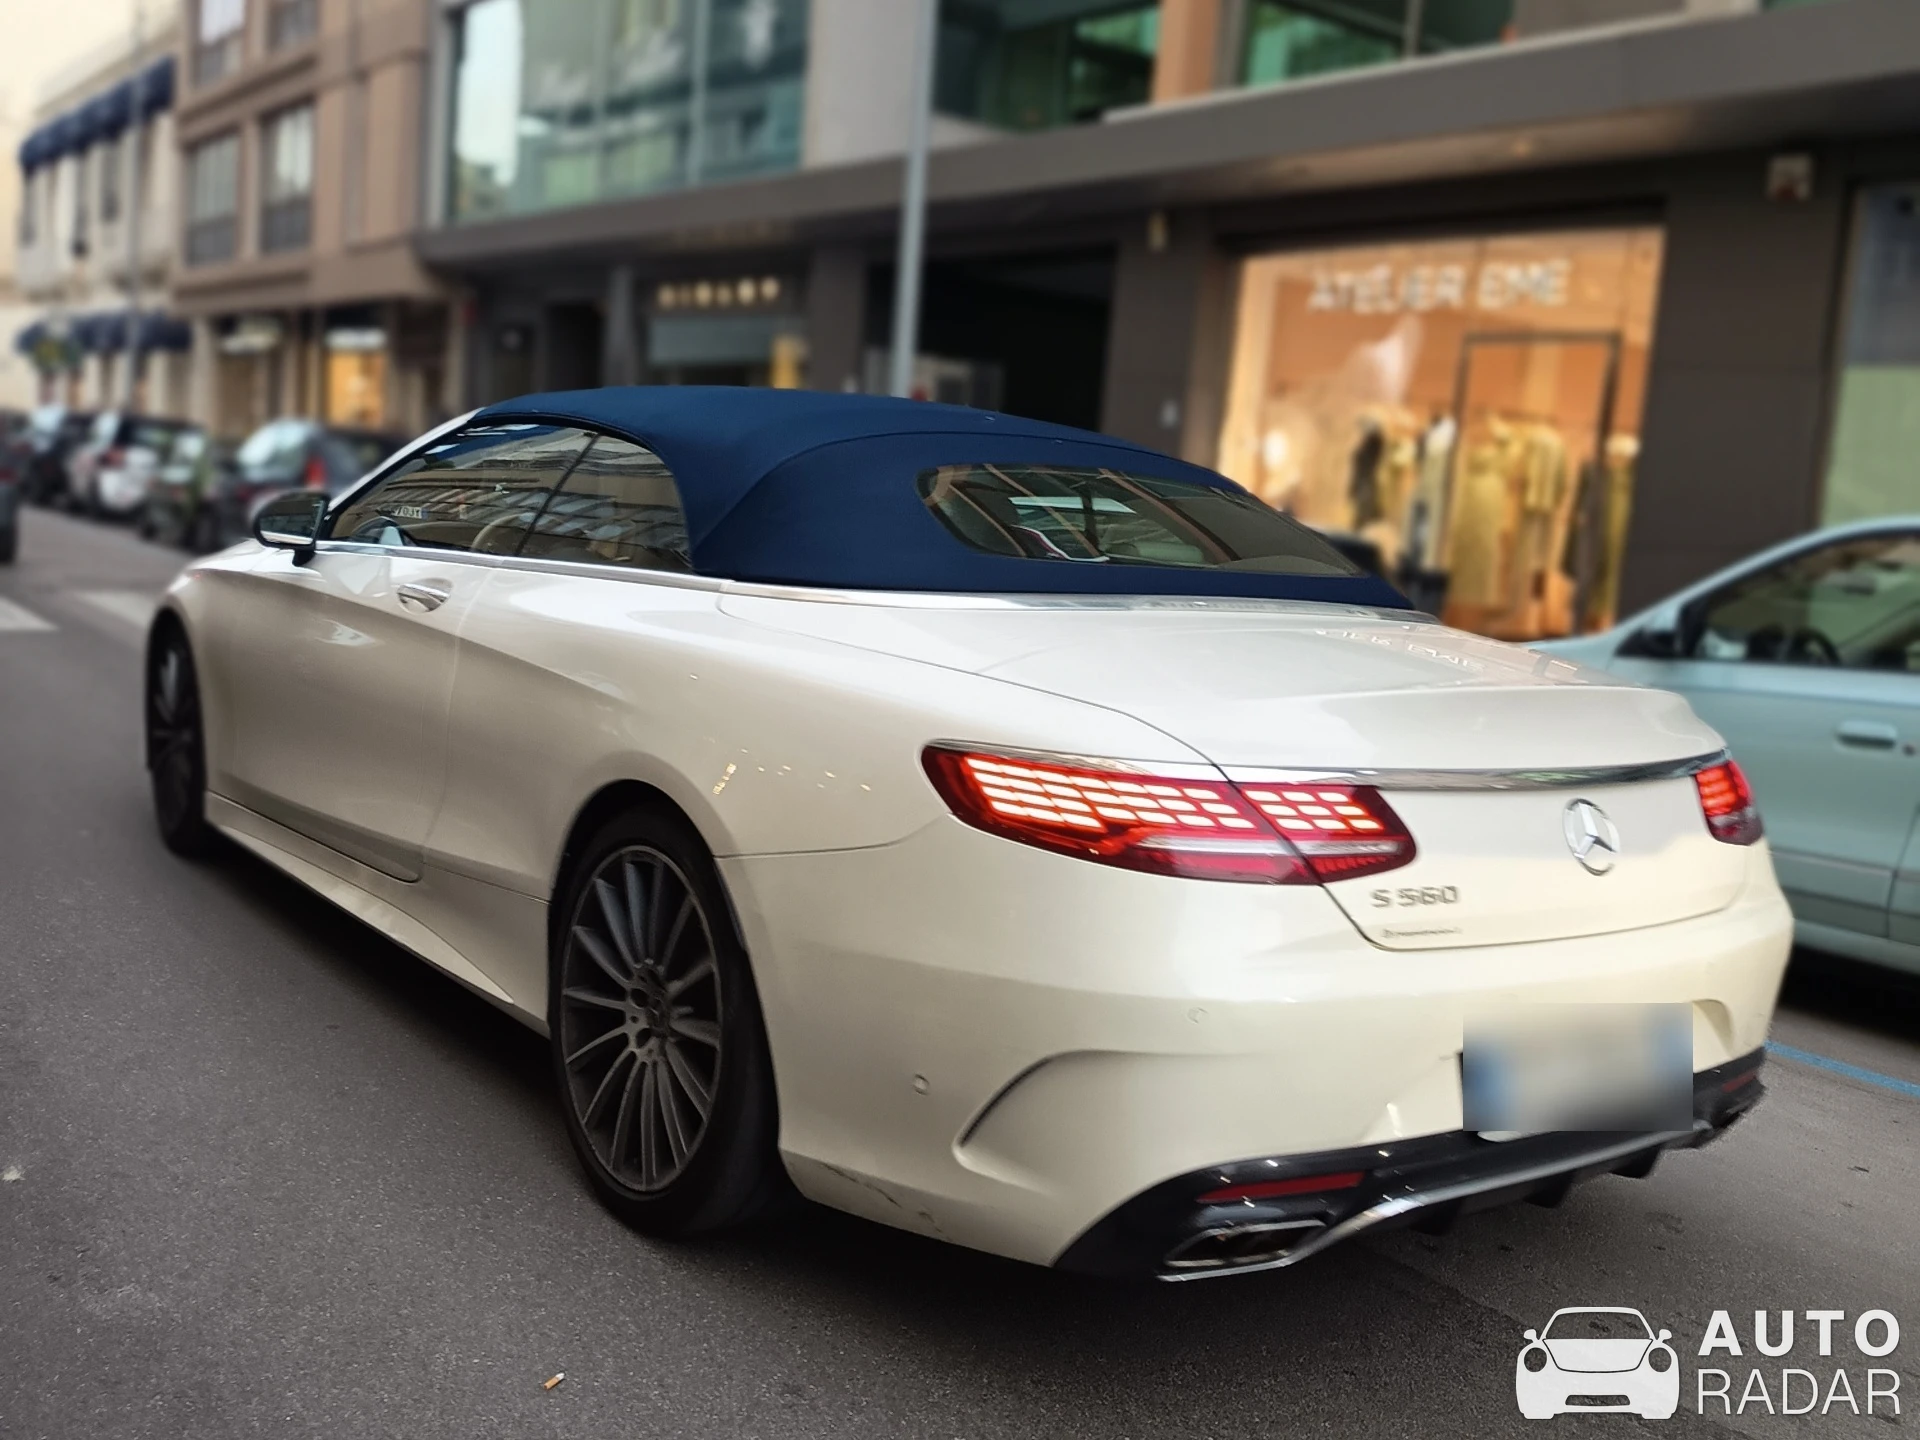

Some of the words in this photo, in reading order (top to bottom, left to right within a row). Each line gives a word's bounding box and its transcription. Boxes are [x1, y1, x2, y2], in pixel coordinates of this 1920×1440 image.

[1308, 262, 1466, 314] ATELIER
[1370, 888, 1391, 908] S
[1397, 885, 1460, 907] 560
